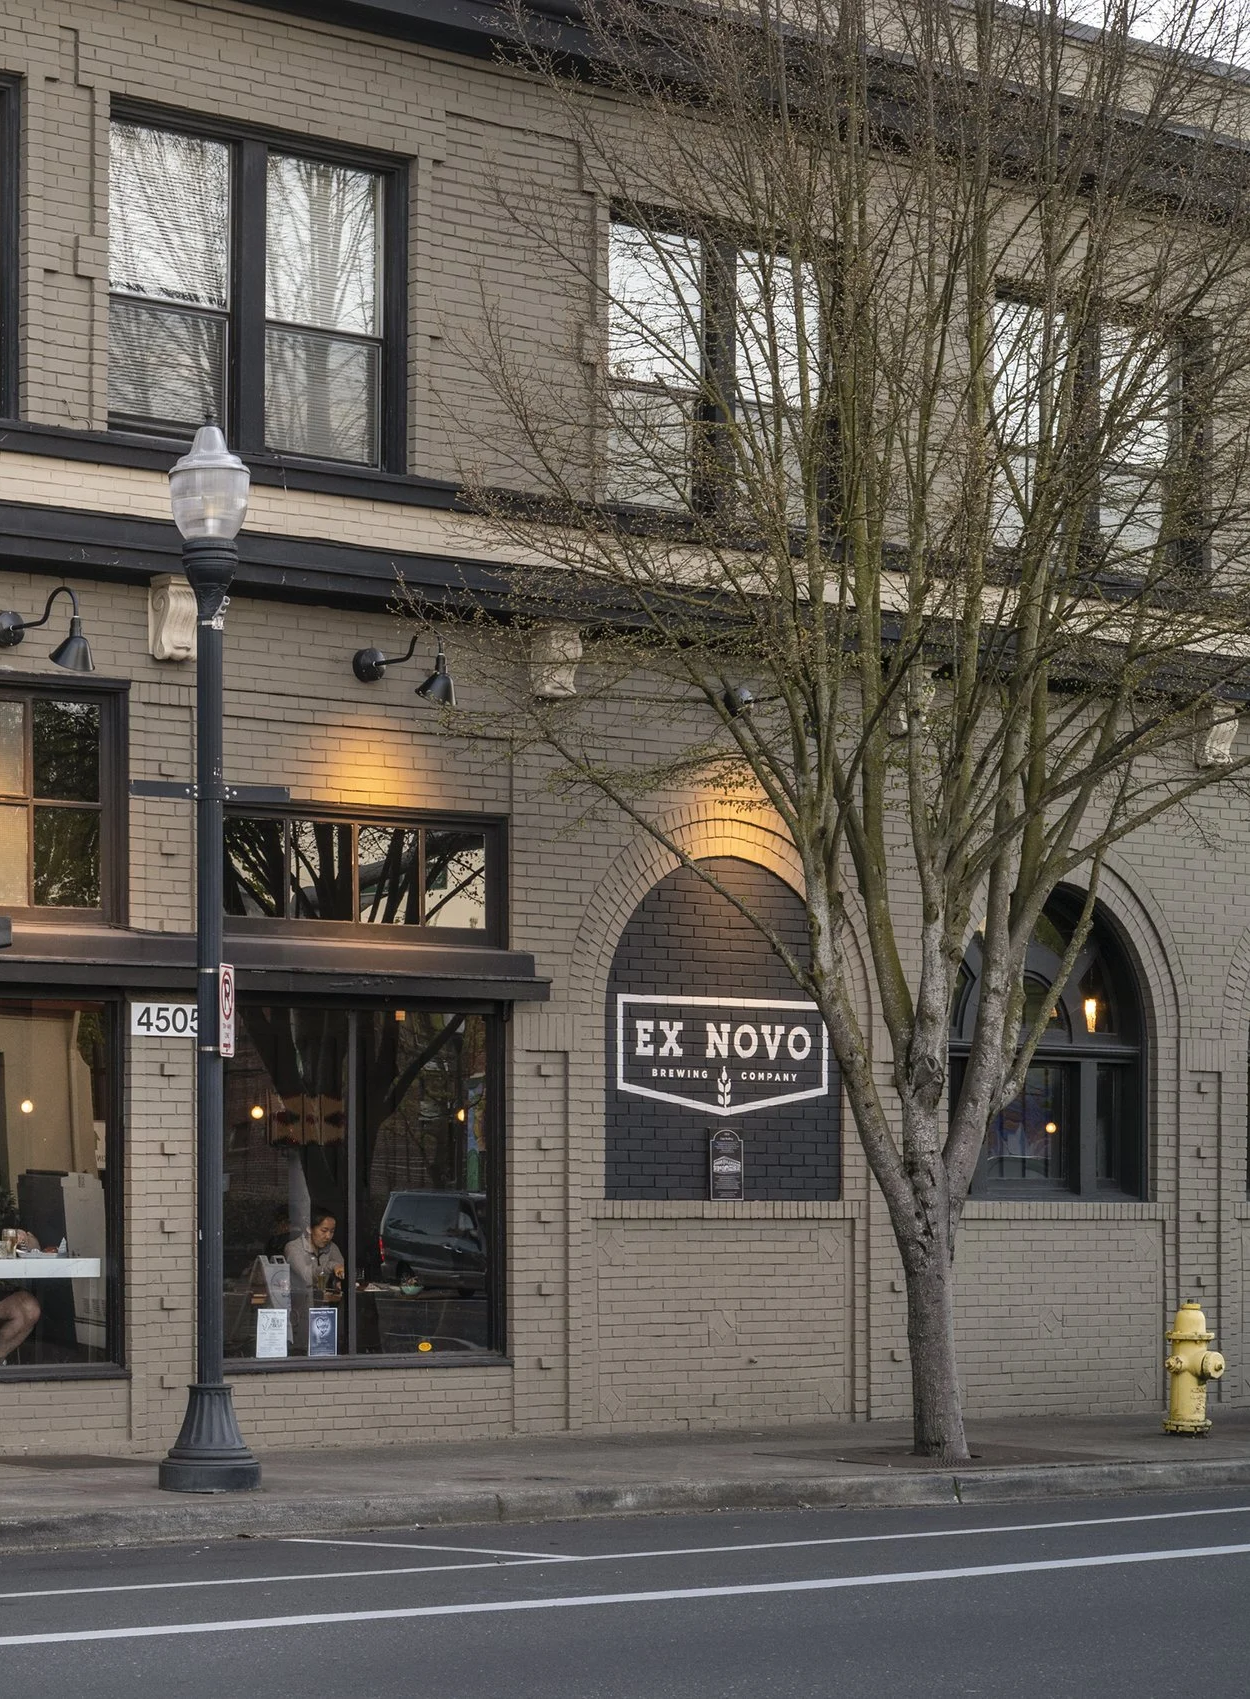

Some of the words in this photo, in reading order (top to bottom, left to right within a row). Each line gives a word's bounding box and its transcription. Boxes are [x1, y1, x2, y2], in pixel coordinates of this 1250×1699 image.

[137, 1007, 198, 1033] 4505
[635, 1020, 683, 1057] EX
[705, 1022, 812, 1060] NOVO
[651, 1068, 708, 1079] BREWING
[741, 1072, 798, 1082] COMPANY
